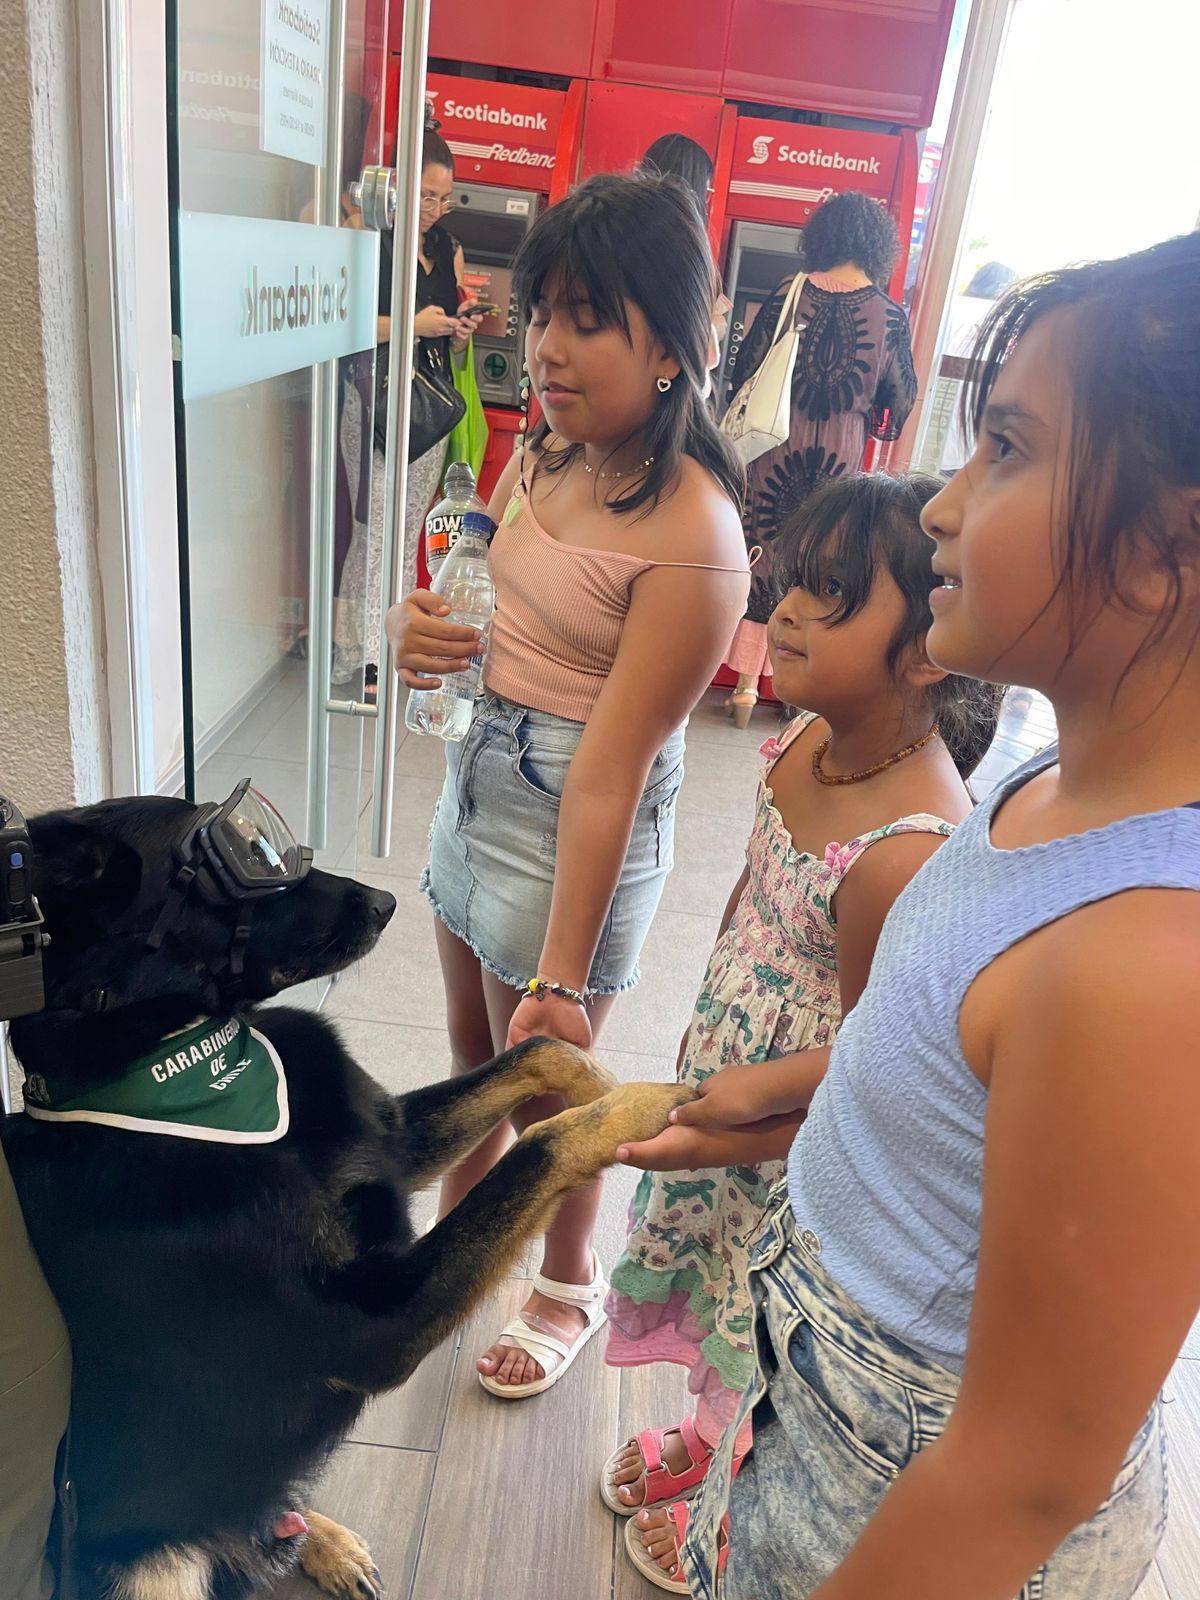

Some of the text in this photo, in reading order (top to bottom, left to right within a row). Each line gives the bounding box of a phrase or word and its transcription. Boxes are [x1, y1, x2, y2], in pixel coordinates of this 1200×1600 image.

[444, 100, 548, 131] Scotiabank
[489, 143, 556, 169] Redbanc
[777, 145, 880, 174] Scotiabank
[426, 515, 464, 537] POW
[210, 1052, 227, 1077] DE
